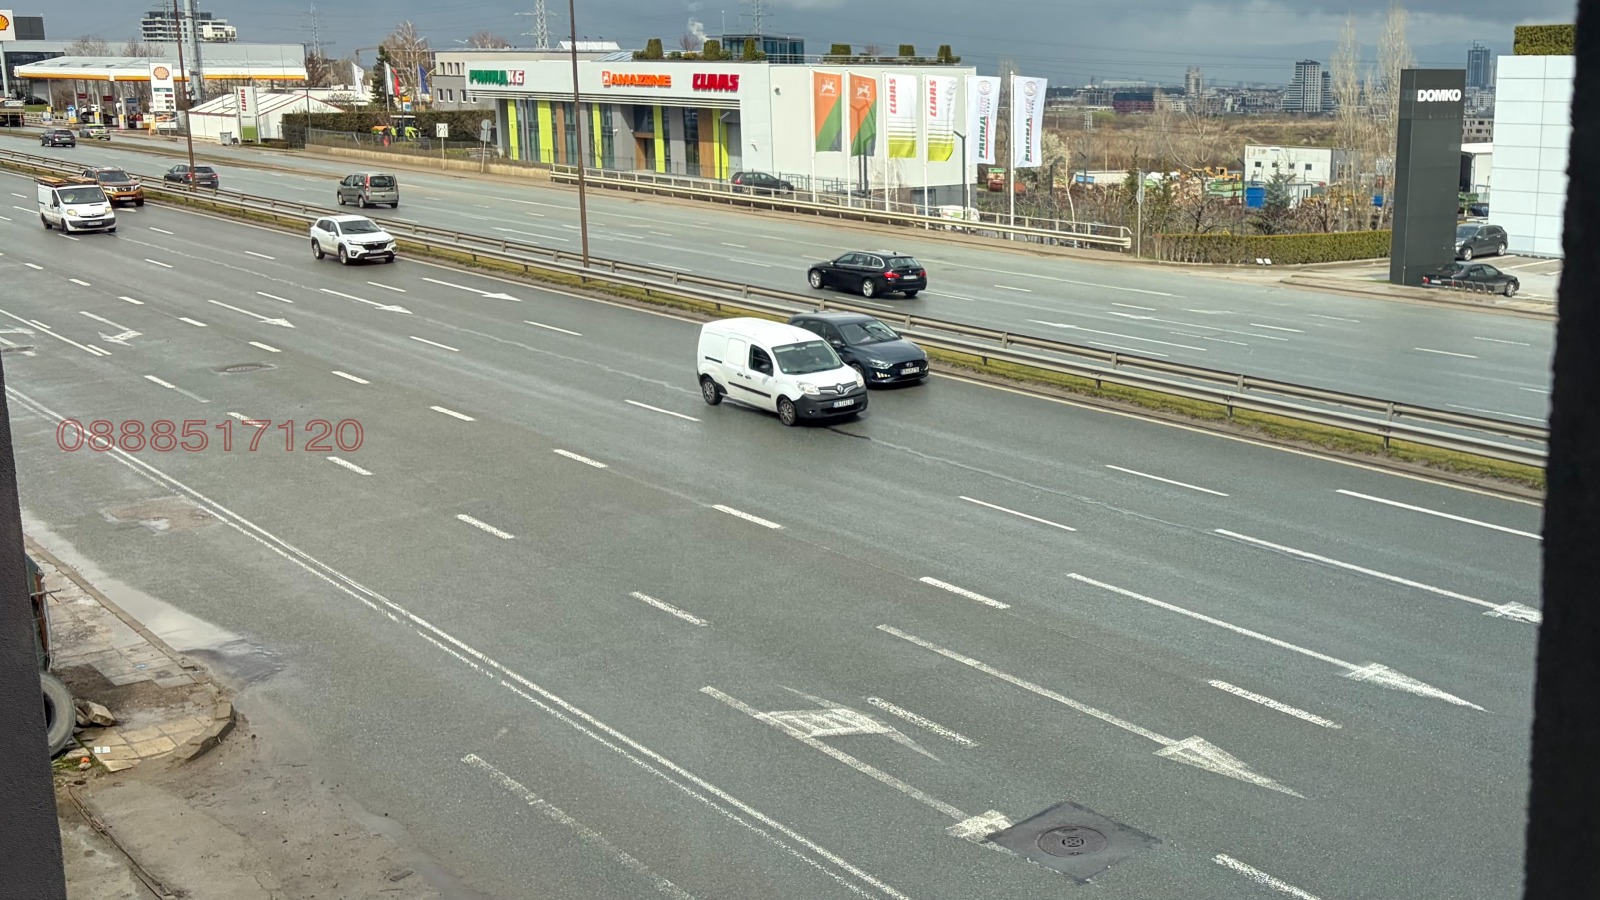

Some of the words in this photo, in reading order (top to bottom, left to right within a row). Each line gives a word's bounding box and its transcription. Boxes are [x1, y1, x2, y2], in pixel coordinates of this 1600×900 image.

[611, 73, 672, 88] AMAZONE
[692, 73, 740, 93] CLAAS
[889, 78, 897, 115] CLAAS
[929, 80, 937, 117] CLAAS
[1417, 89, 1462, 102] DOMKO
